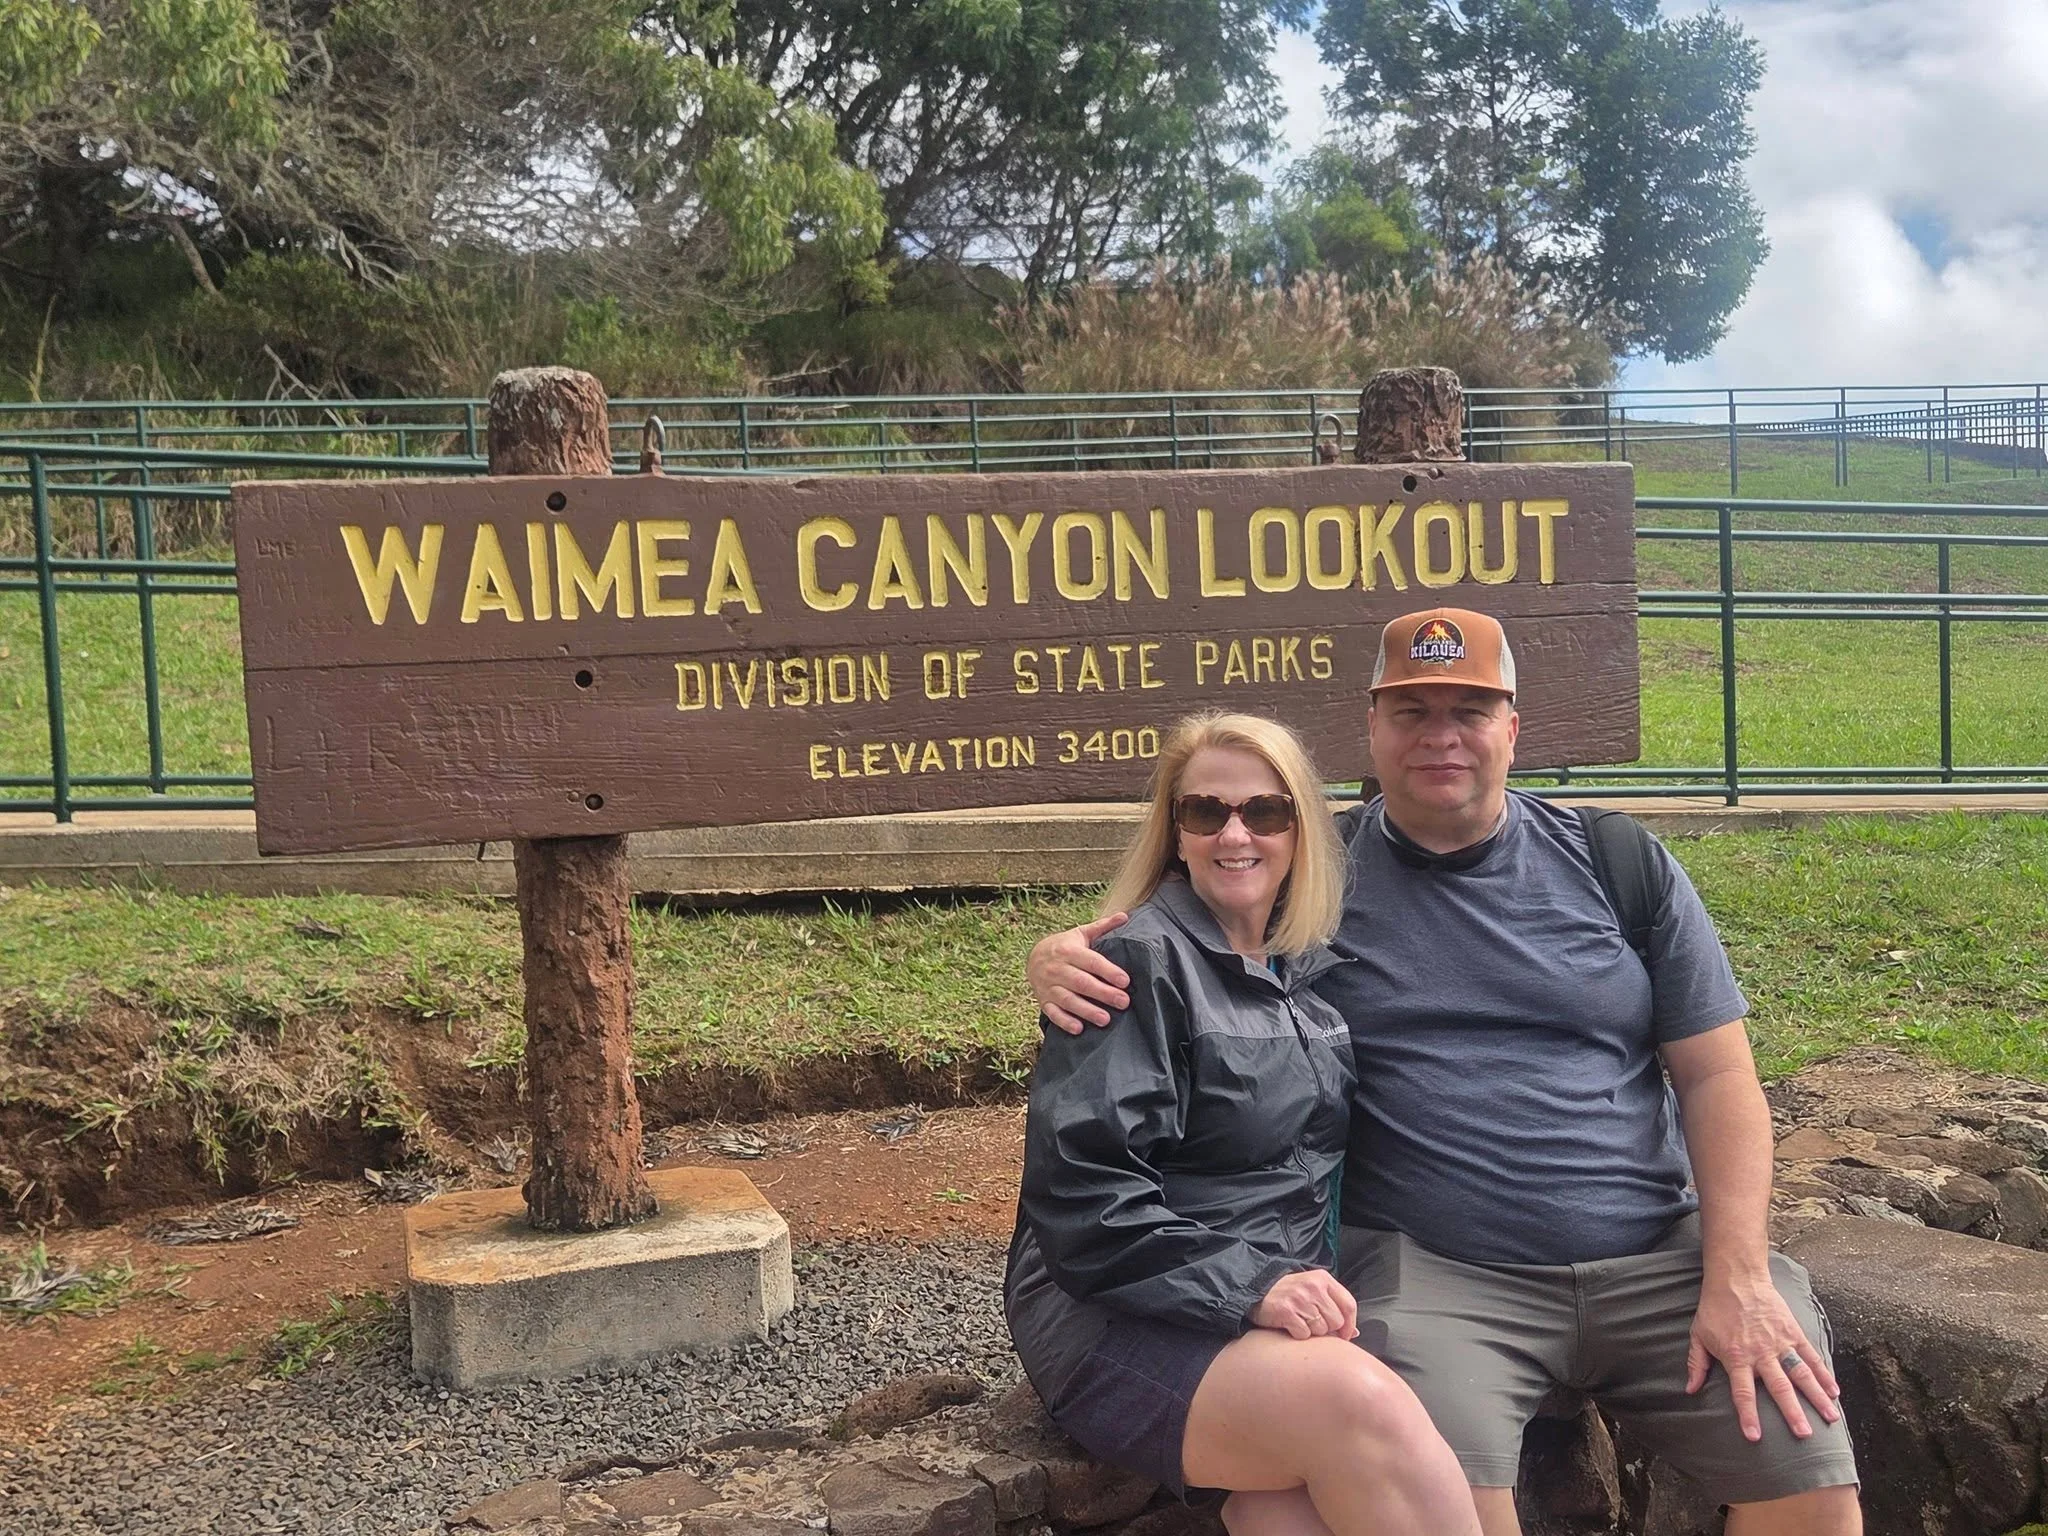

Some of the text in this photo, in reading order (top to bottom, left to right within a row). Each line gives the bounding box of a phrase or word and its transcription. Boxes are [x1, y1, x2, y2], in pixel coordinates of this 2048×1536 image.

[339, 498, 1571, 626] WAIMEA CANYON LOOKOUT
[673, 633, 1335, 713] DIVISION OF STATE PARKS
[1410, 644, 1465, 659] KILAUEA
[809, 726, 1161, 782] ELEVATION 3400
